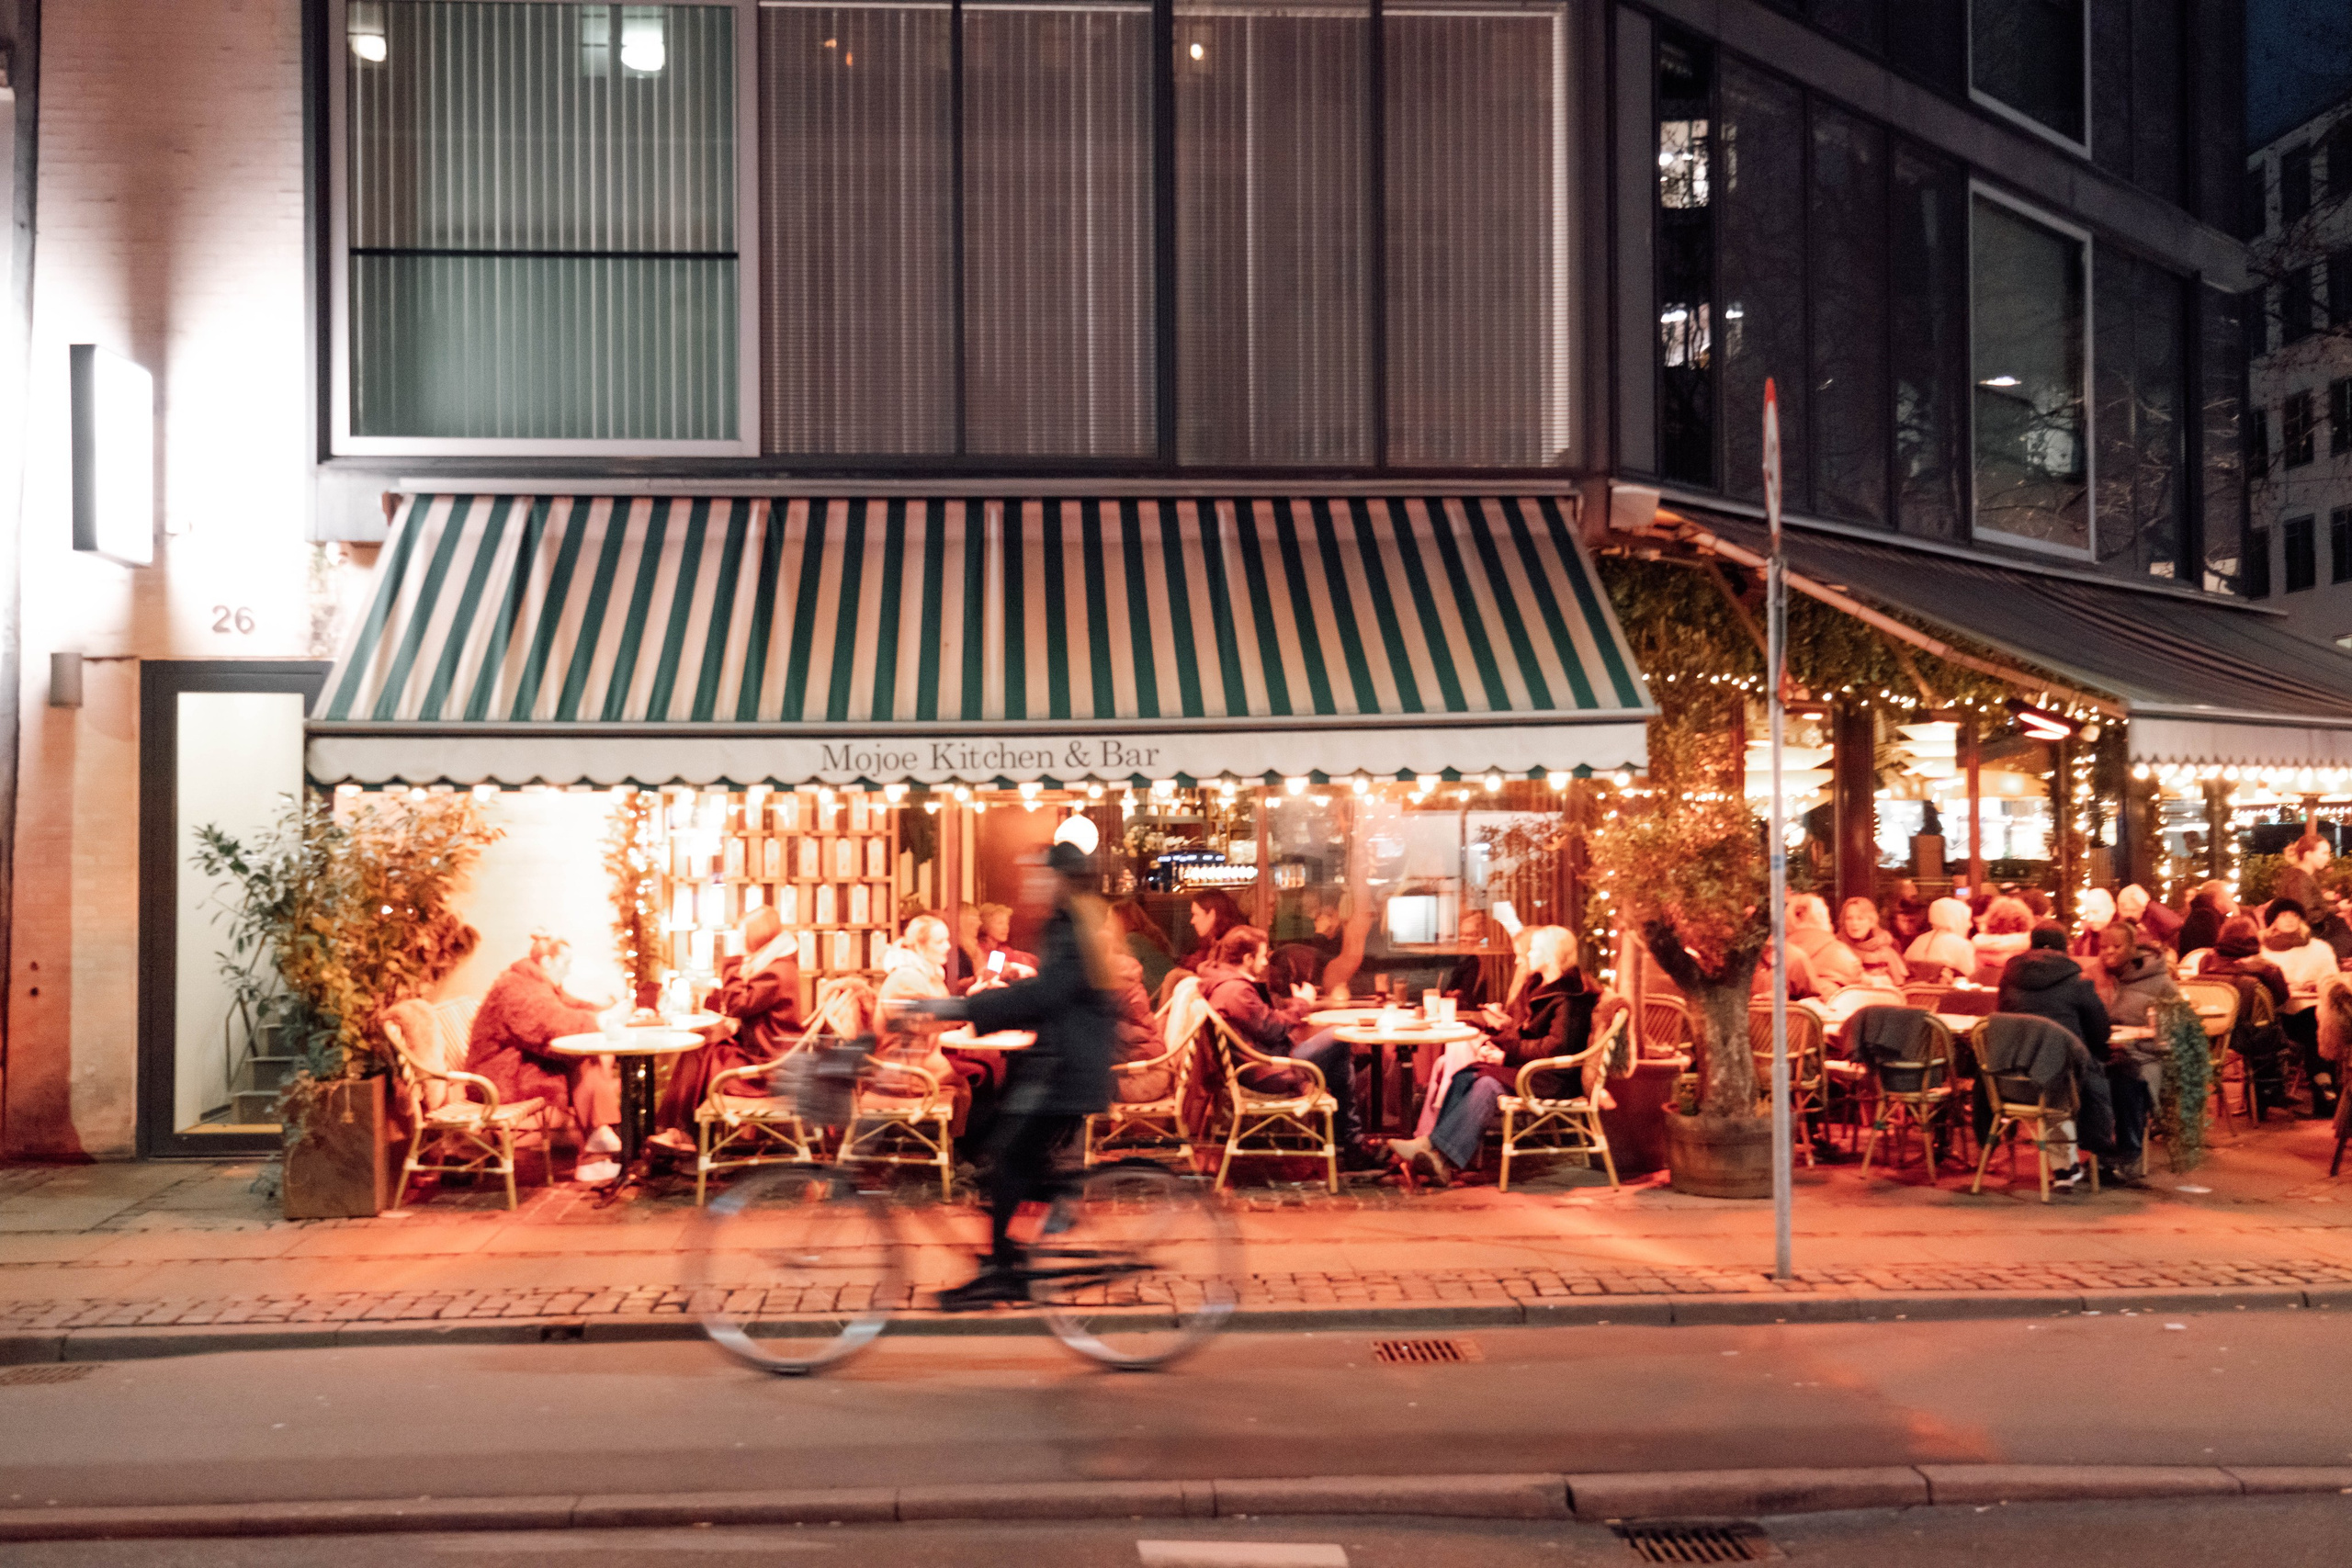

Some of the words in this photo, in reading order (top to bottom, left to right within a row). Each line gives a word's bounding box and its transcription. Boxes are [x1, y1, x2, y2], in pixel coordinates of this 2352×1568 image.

[212, 605, 255, 634] 26
[821, 743, 919, 776] Mojoe
[929, 741, 1055, 770] Kitchen
[1064, 740, 1091, 768] &
[1102, 739, 1159, 768] Bar
